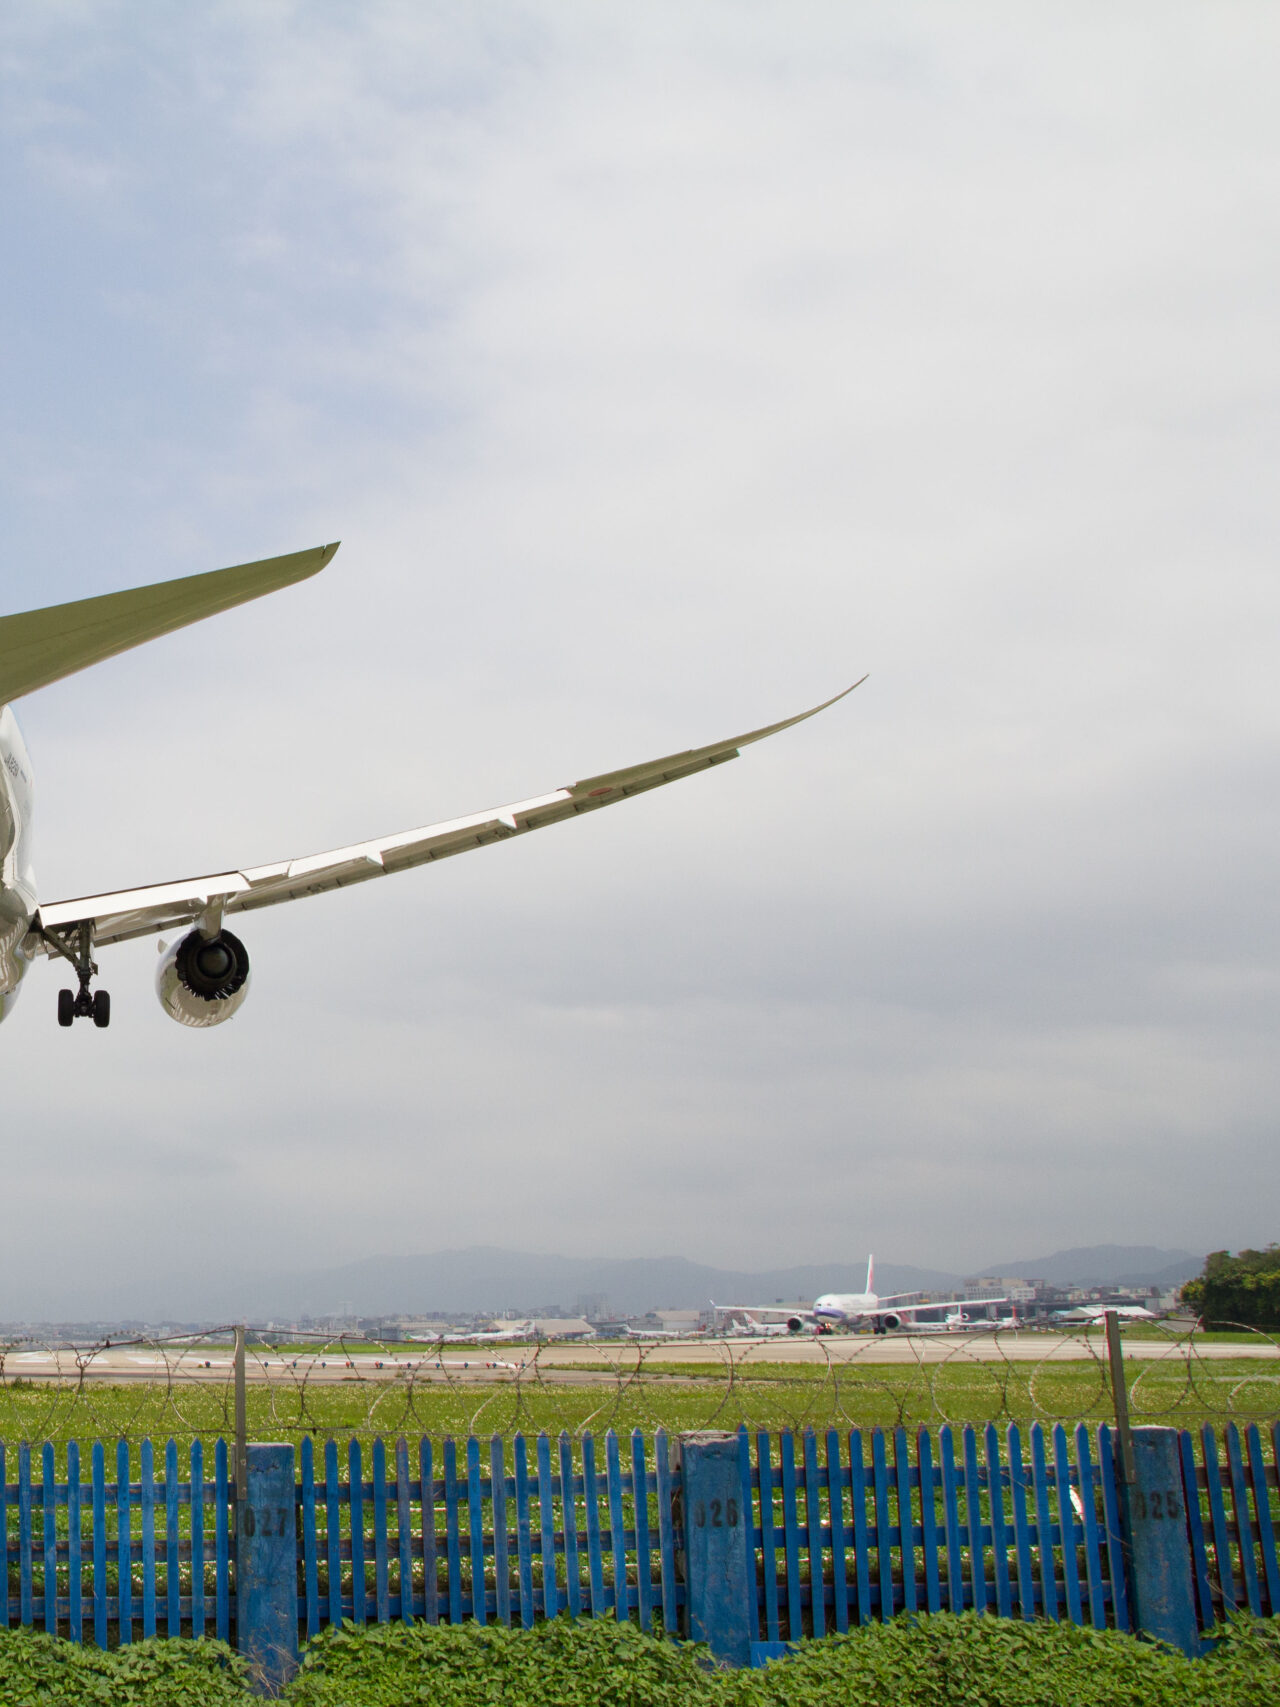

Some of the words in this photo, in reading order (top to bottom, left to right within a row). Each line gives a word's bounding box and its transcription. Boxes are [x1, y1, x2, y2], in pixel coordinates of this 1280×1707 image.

[695, 1497, 737, 1528] 026
[1132, 1489, 1179, 1521] 025
[244, 1508, 288, 1537] 027
